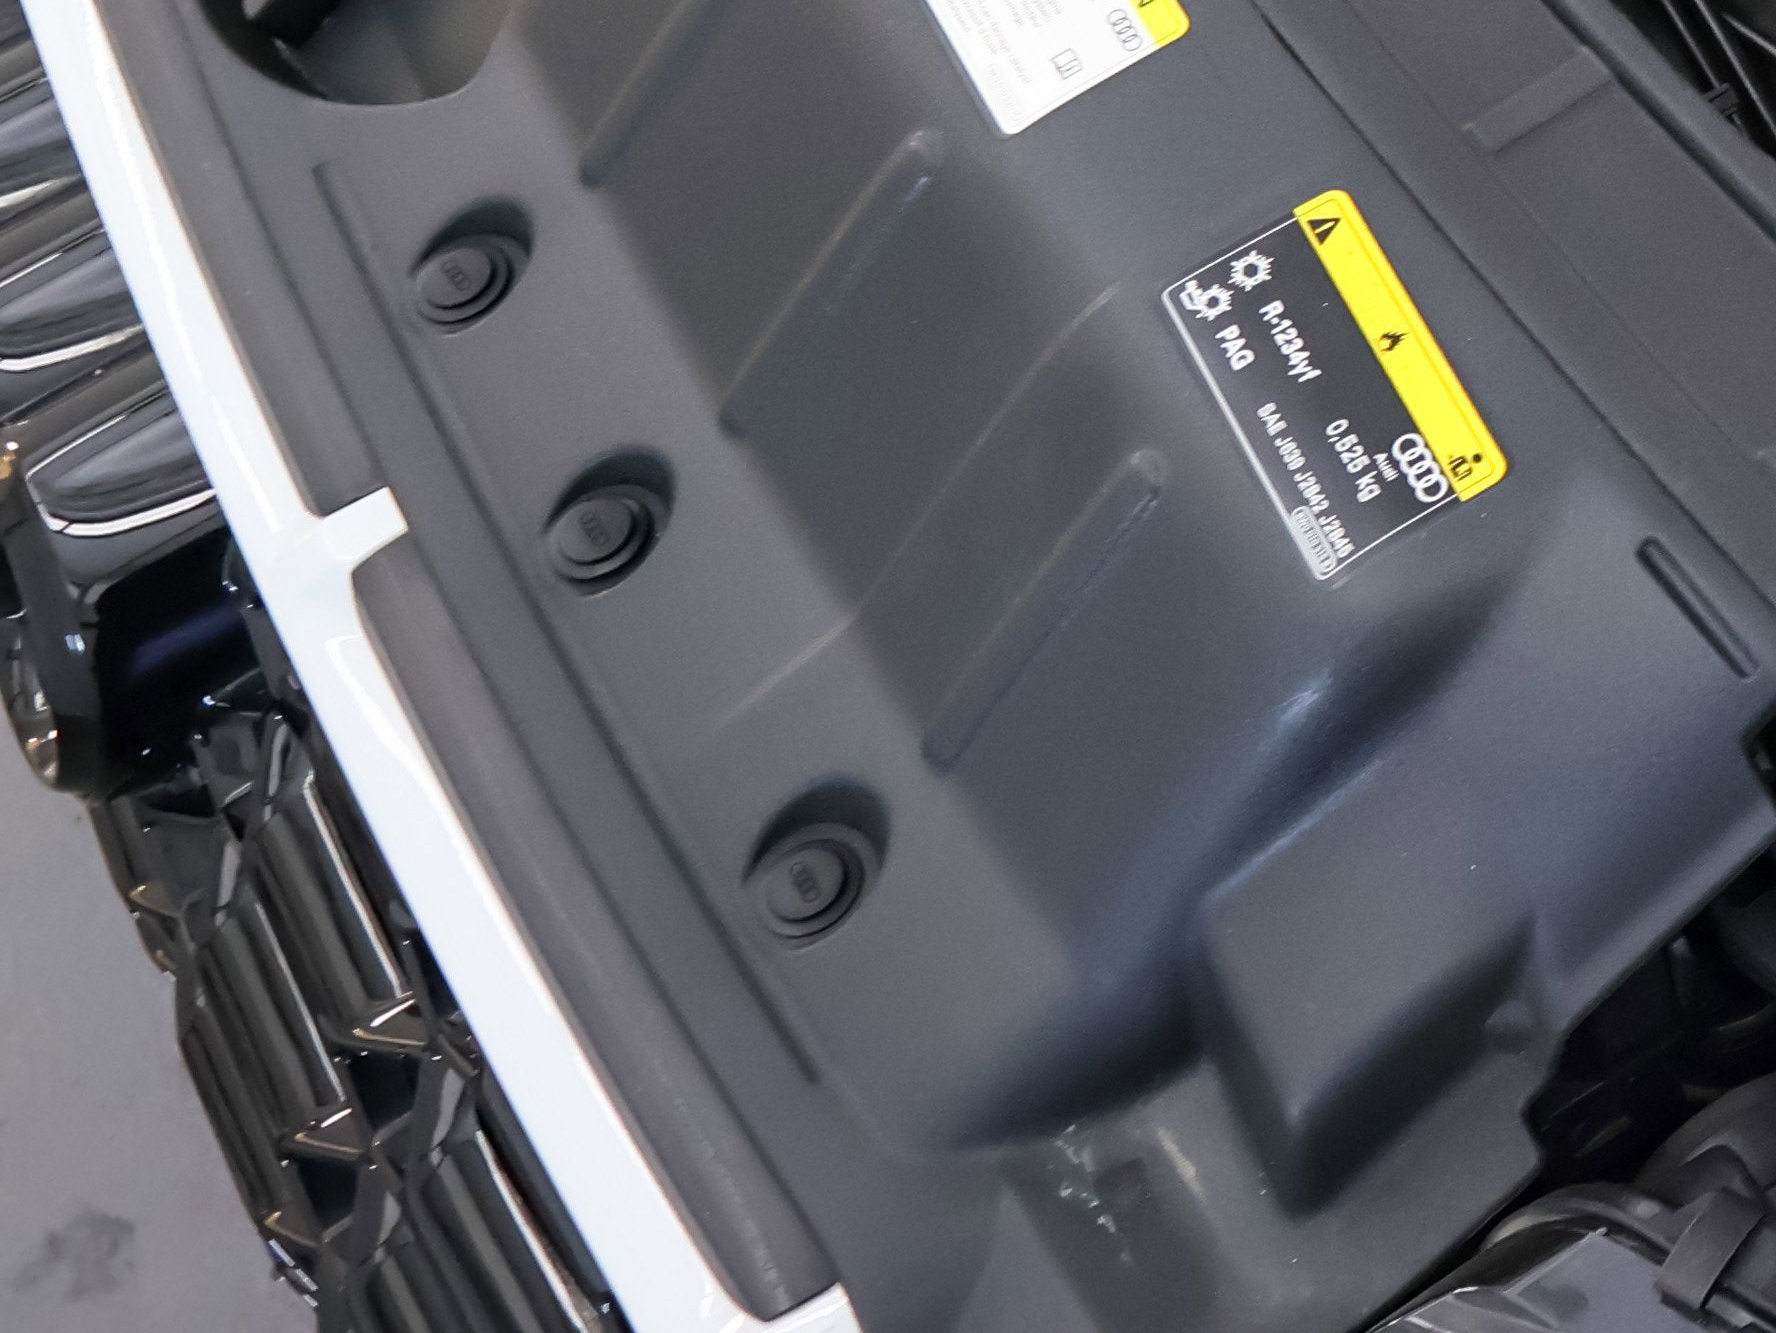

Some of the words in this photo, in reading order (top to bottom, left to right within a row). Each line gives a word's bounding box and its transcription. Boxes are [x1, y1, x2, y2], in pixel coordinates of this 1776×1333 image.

[1214, 323, 1256, 372] PAG
[1258, 299, 1322, 384] R-1234yf
[1354, 472, 1383, 503] kg
[1372, 449, 1399, 482] Audi
